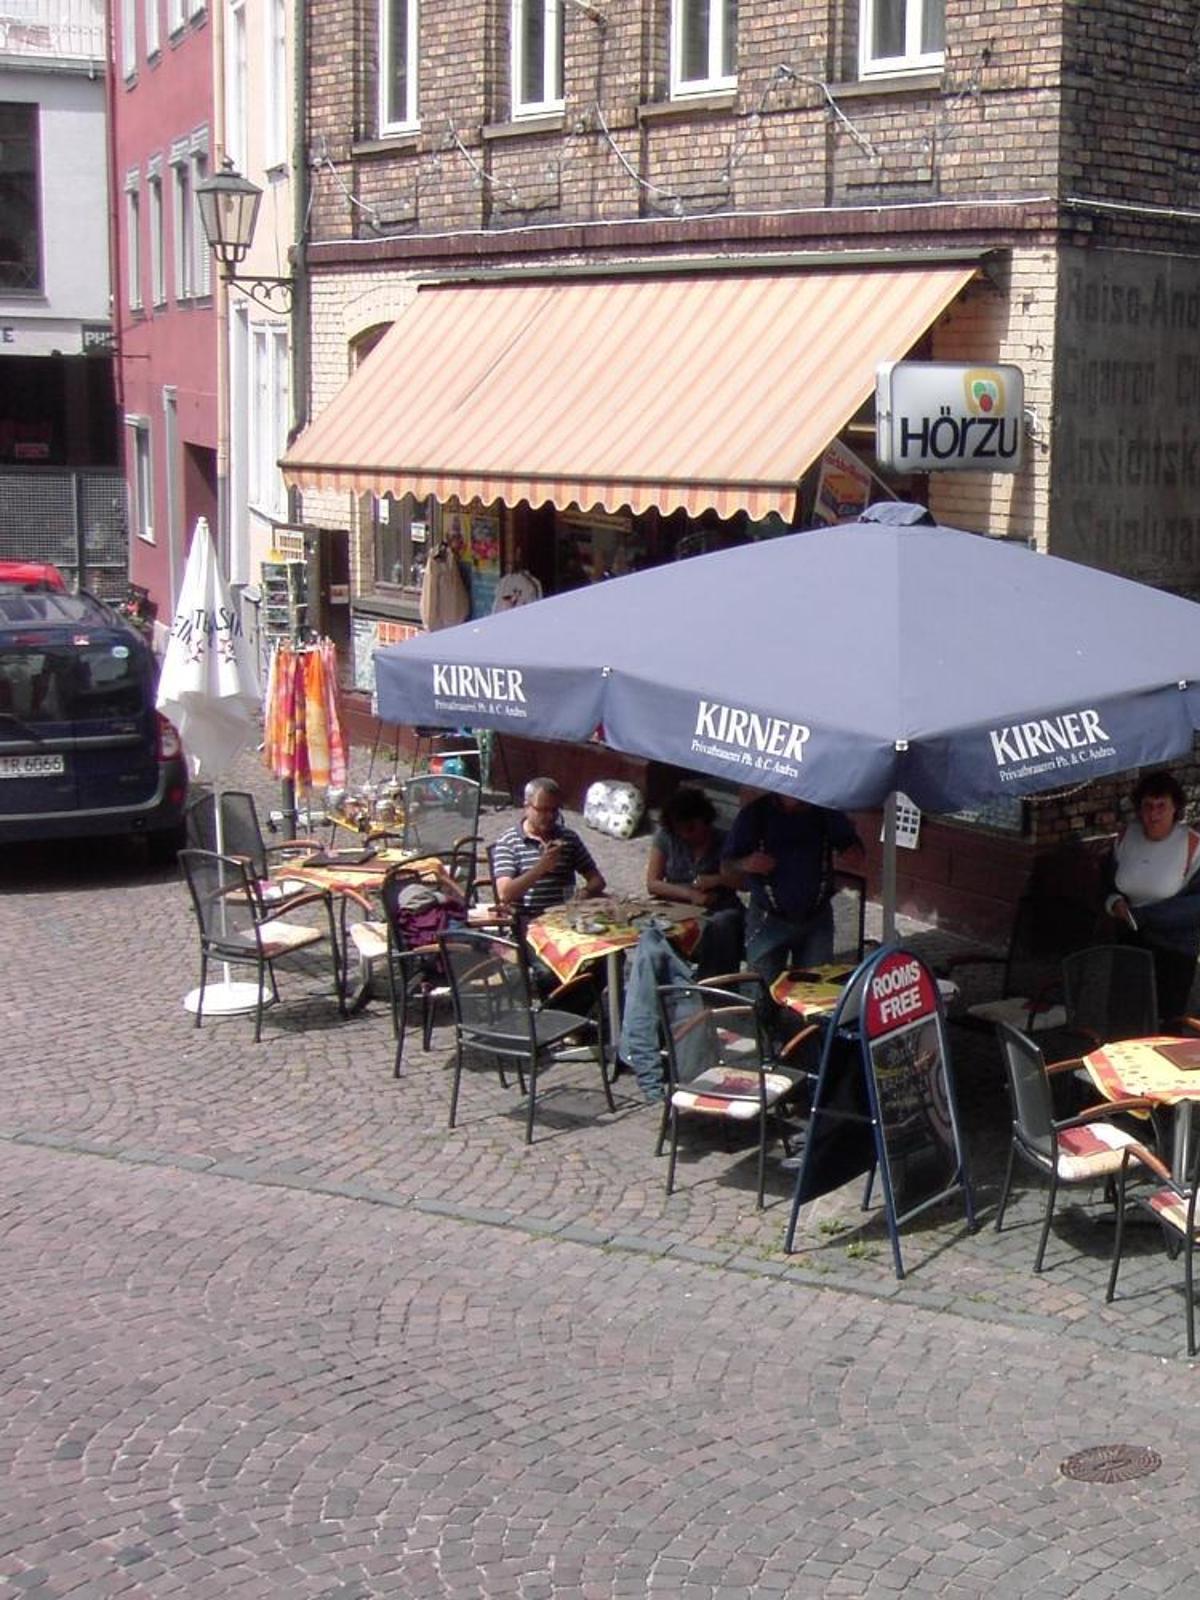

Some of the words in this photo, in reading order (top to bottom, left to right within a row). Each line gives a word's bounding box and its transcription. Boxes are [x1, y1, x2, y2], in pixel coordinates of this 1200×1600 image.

[433, 663, 528, 703] KIRNER
[695, 700, 811, 762] KIRNER
[989, 708, 1111, 766] KIRNER
[872, 960, 921, 1000] ROOMS
[880, 986, 922, 1024] FREE
